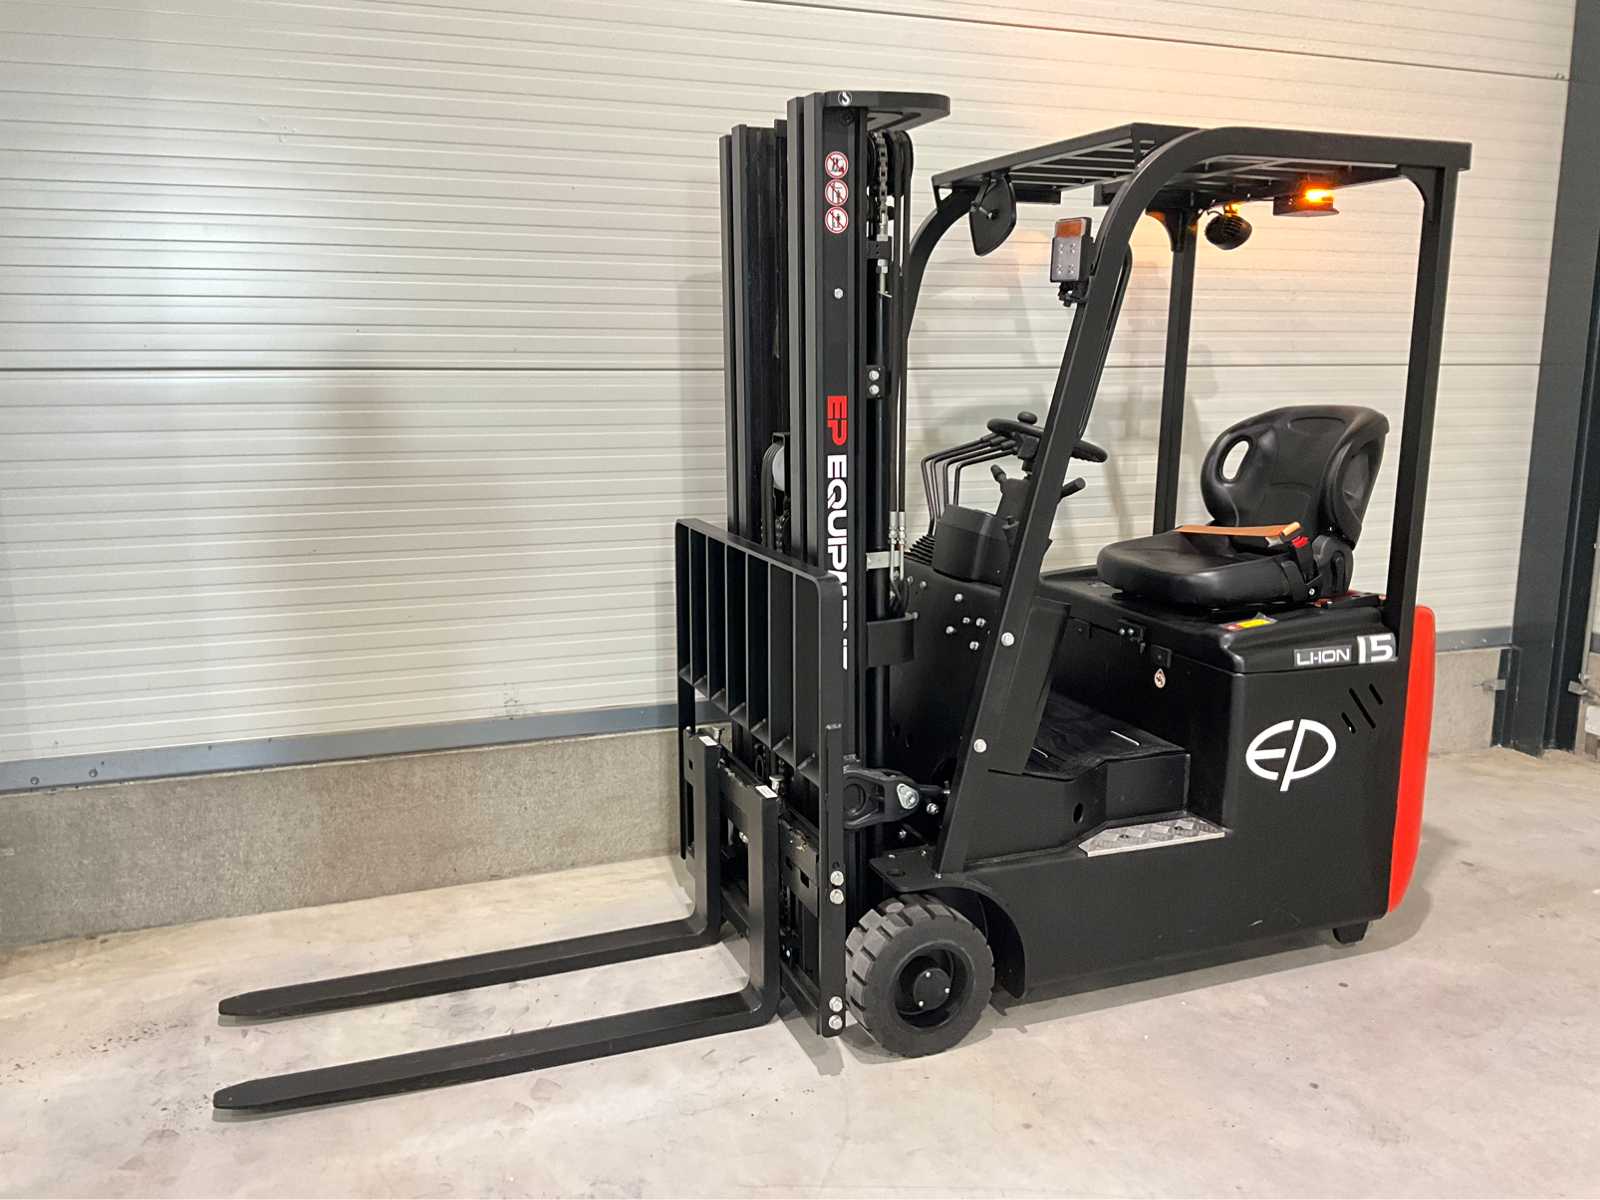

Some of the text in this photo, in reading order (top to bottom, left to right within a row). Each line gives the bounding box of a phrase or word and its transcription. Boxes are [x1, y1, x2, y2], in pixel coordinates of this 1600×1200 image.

[827, 395, 848, 671] EP EQUIP
[1296, 633, 1393, 666] LI-ION 15
[1245, 719, 1337, 792] EP
